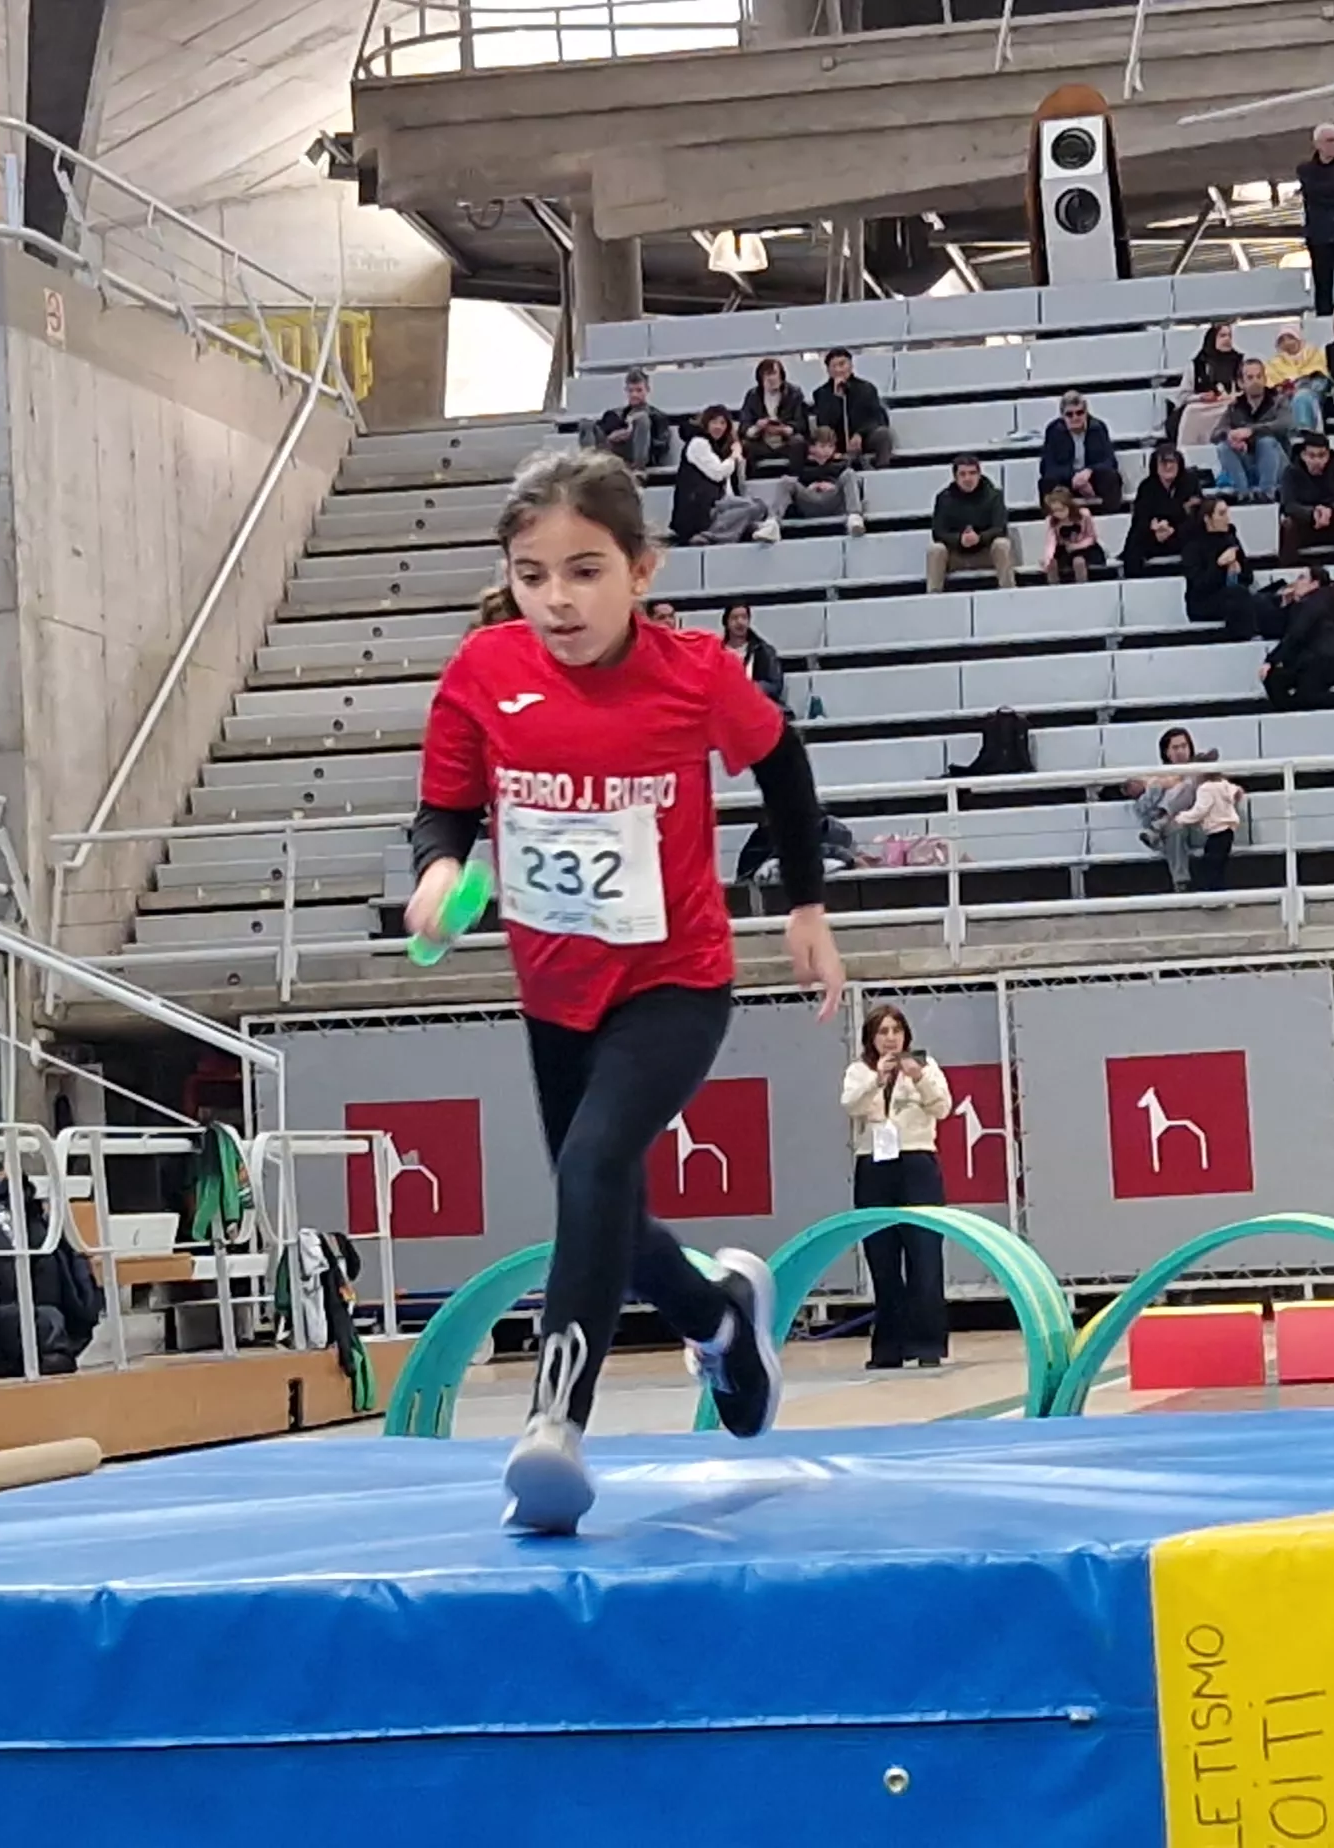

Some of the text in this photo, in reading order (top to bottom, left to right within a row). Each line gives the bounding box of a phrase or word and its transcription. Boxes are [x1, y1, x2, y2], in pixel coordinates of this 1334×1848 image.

[495, 766, 677, 810] PEDRO J. RUBIO
[520, 845, 625, 901] 232
